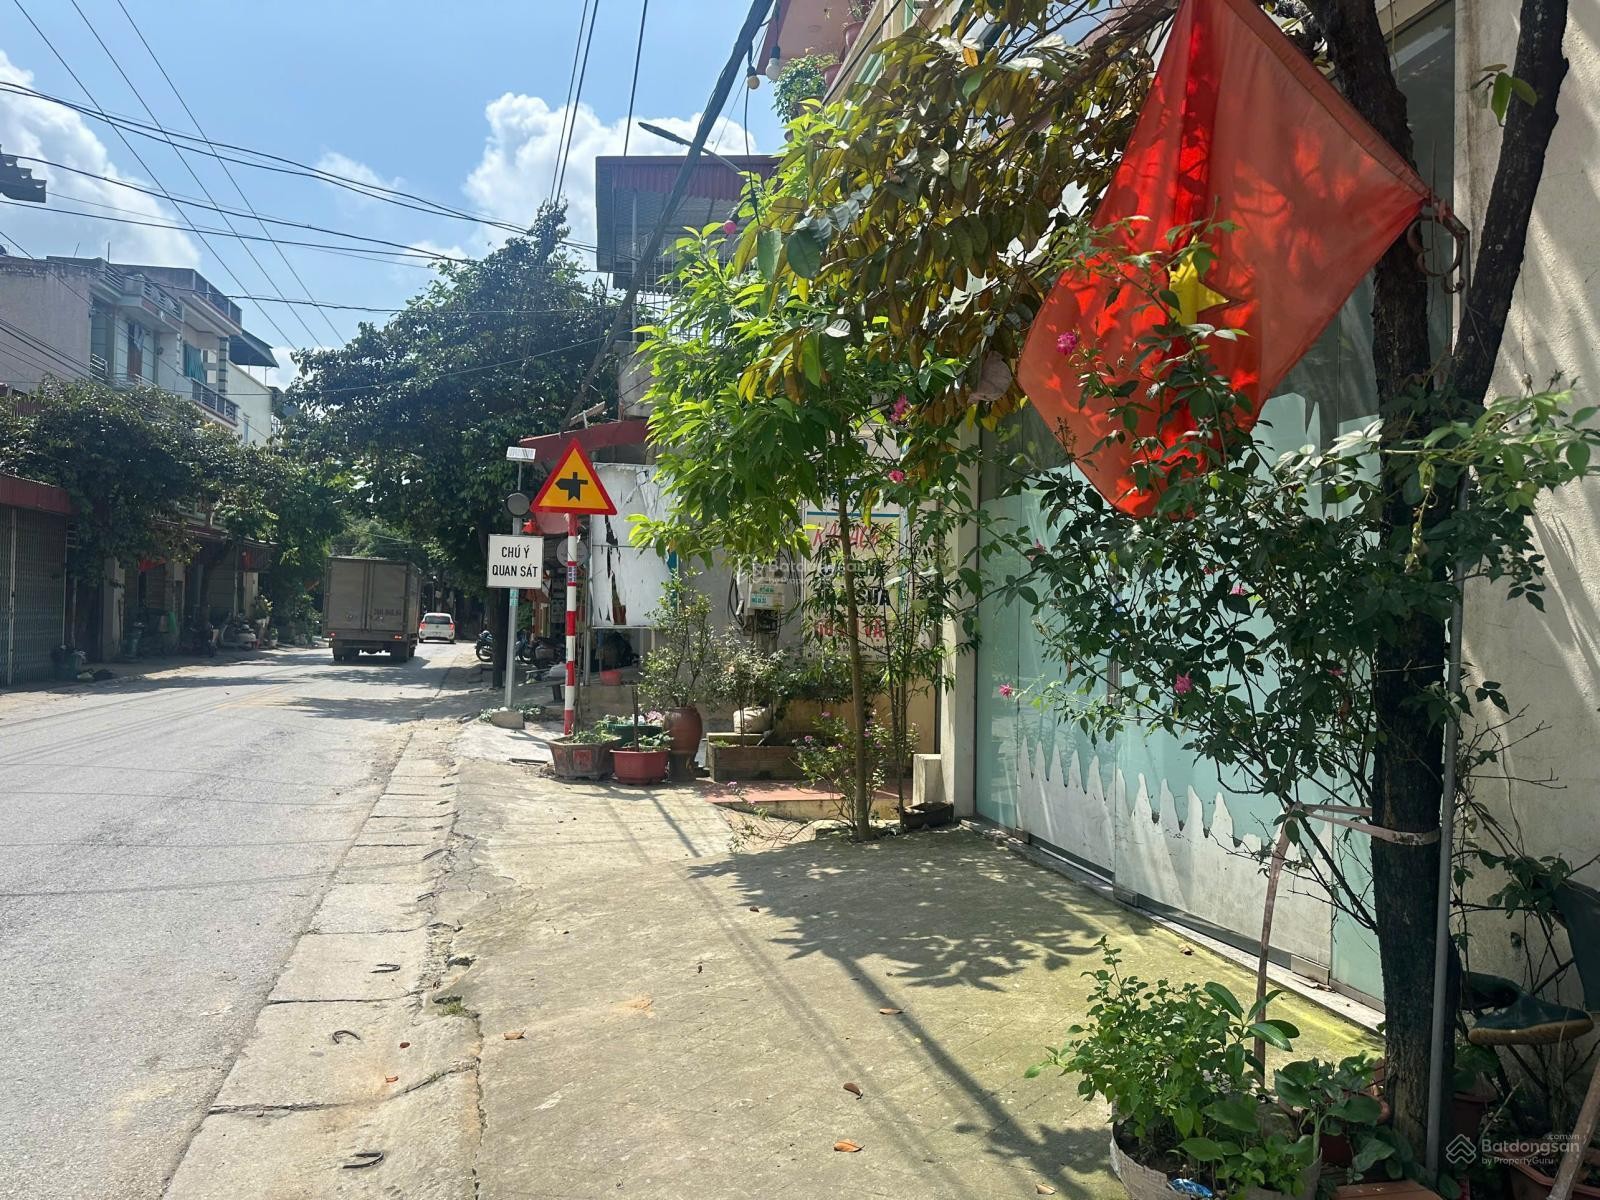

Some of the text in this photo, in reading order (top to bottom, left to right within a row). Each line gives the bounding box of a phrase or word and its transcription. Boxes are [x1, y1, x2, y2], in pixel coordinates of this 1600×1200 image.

[501, 544, 530, 558] CHÚ Ý
[492, 563, 538, 577] QUAN SÁT
